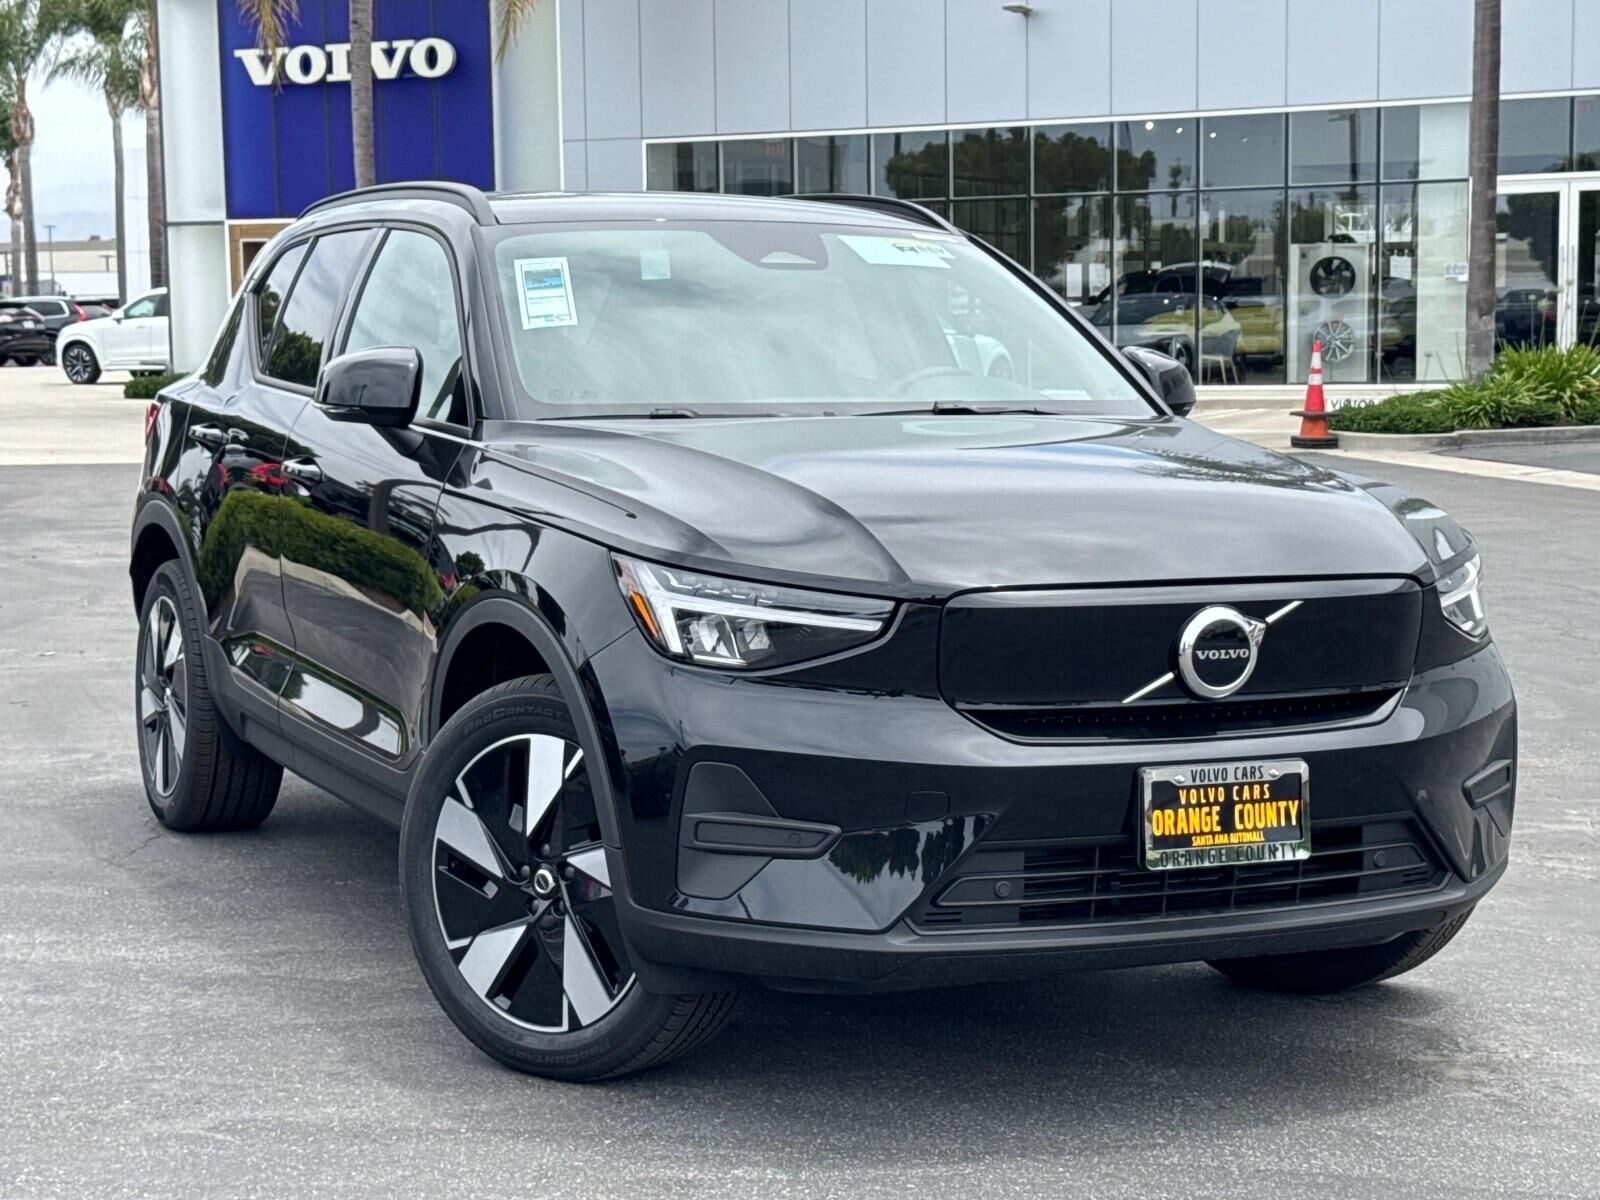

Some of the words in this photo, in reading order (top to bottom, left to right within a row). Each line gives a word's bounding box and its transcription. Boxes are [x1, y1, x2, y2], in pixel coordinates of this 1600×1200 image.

[1195, 648, 1250, 660] VOLVO
[1190, 767, 1228, 783] VOLVO
[1234, 765, 1264, 781] CARS
[1179, 786, 1225, 805] VOLVO
[1232, 783, 1270, 801] CARS
[1152, 805, 1222, 836] ORANGE
[1234, 800, 1299, 830] COUNTY
[1191, 834, 1213, 847] SANTA
[1214, 833, 1229, 845] ANA
[1229, 831, 1265, 844] AUTOMALL
[1160, 848, 1226, 868] ORANGE
[1236, 842, 1299, 861] COUNTY
